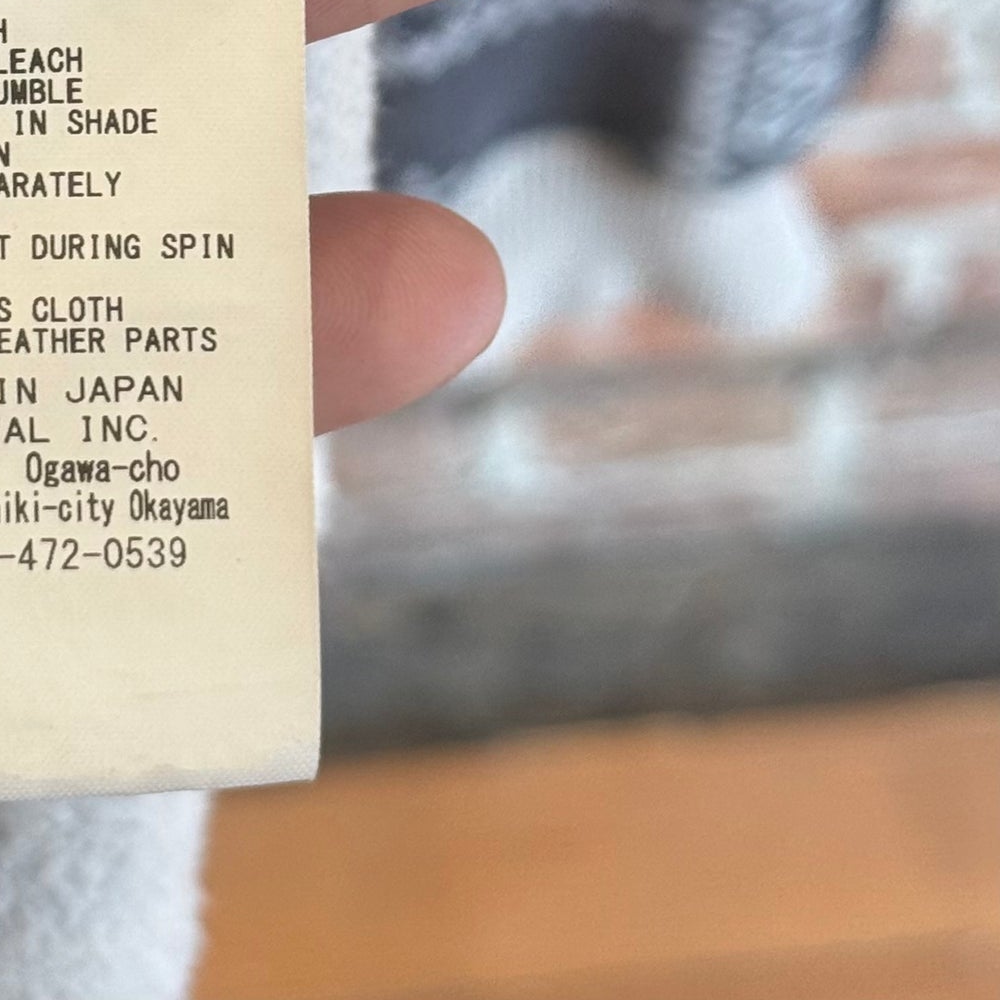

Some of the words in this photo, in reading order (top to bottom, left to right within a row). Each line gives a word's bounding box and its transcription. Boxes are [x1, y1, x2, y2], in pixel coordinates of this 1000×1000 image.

[15, 111, 47, 135] IN
[66, 109, 158, 135] SHADE
[30, 234, 142, 260] DURING
[159, 234, 235, 259] SPIN
[31, 297, 125, 323] CLOTH
[124, 327, 219, 353] PARTS
[65, 376, 184, 403] JAPAN
[81, 415, 158, 442] INC.
[25, 451, 181, 485] Ogawa-cho
[128, 492, 230, 525] Okayama
